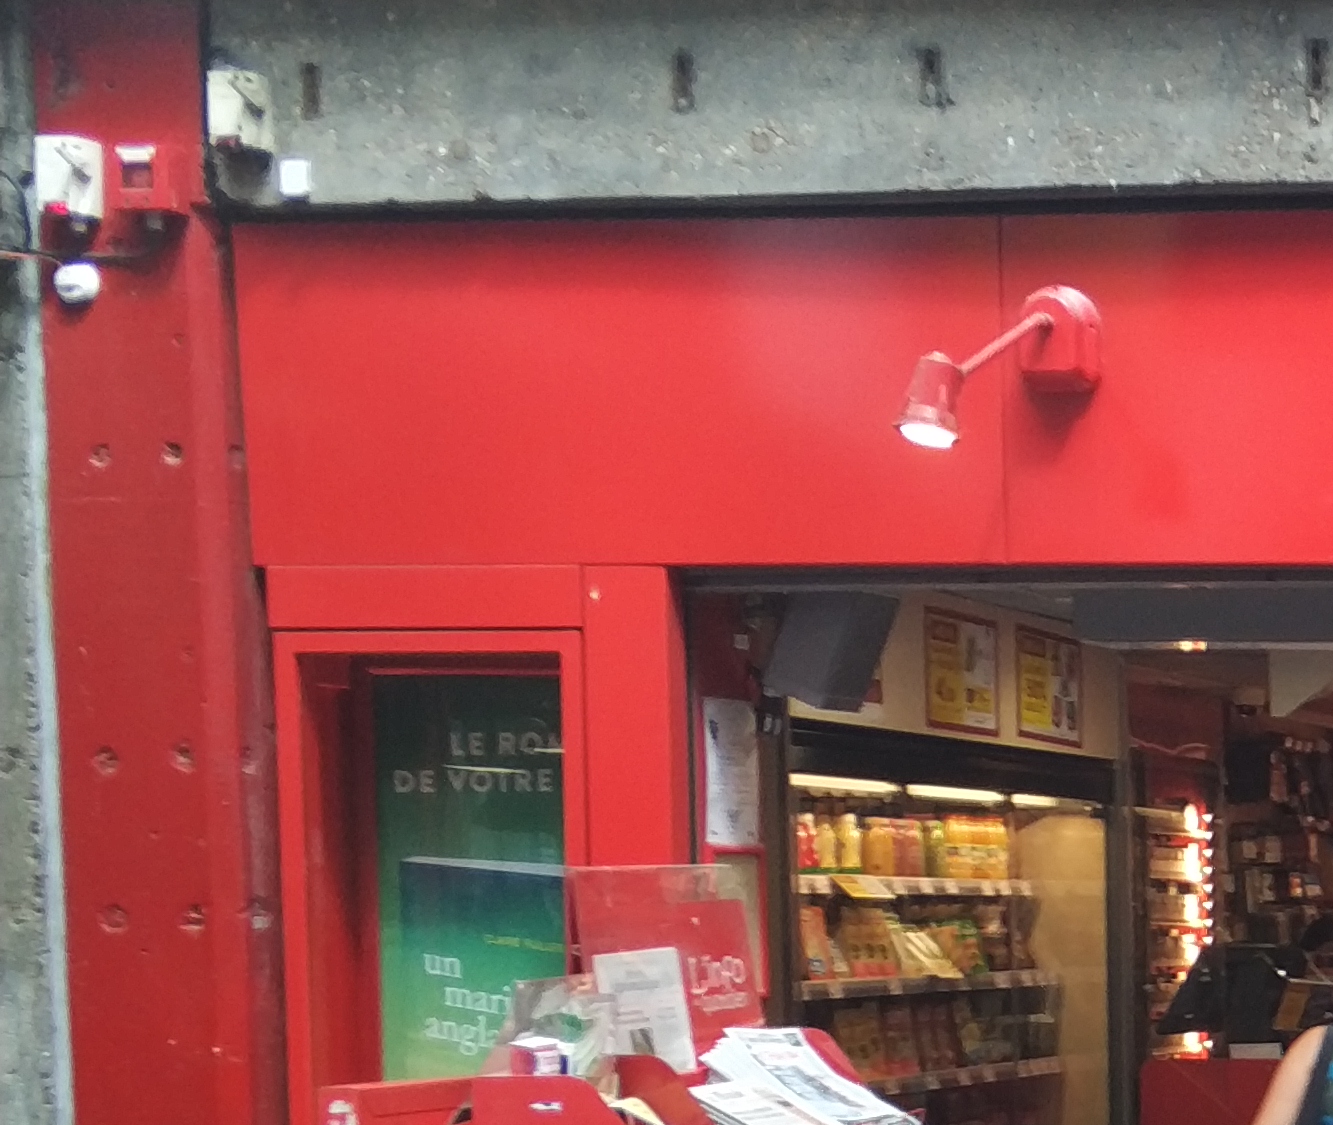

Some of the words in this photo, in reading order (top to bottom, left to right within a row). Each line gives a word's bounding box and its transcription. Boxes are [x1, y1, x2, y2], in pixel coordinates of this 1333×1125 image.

[449, 731, 484, 757] LE
[392, 769, 437, 793] DE
[446, 768, 555, 793] VOTRE
[423, 954, 462, 979] un
